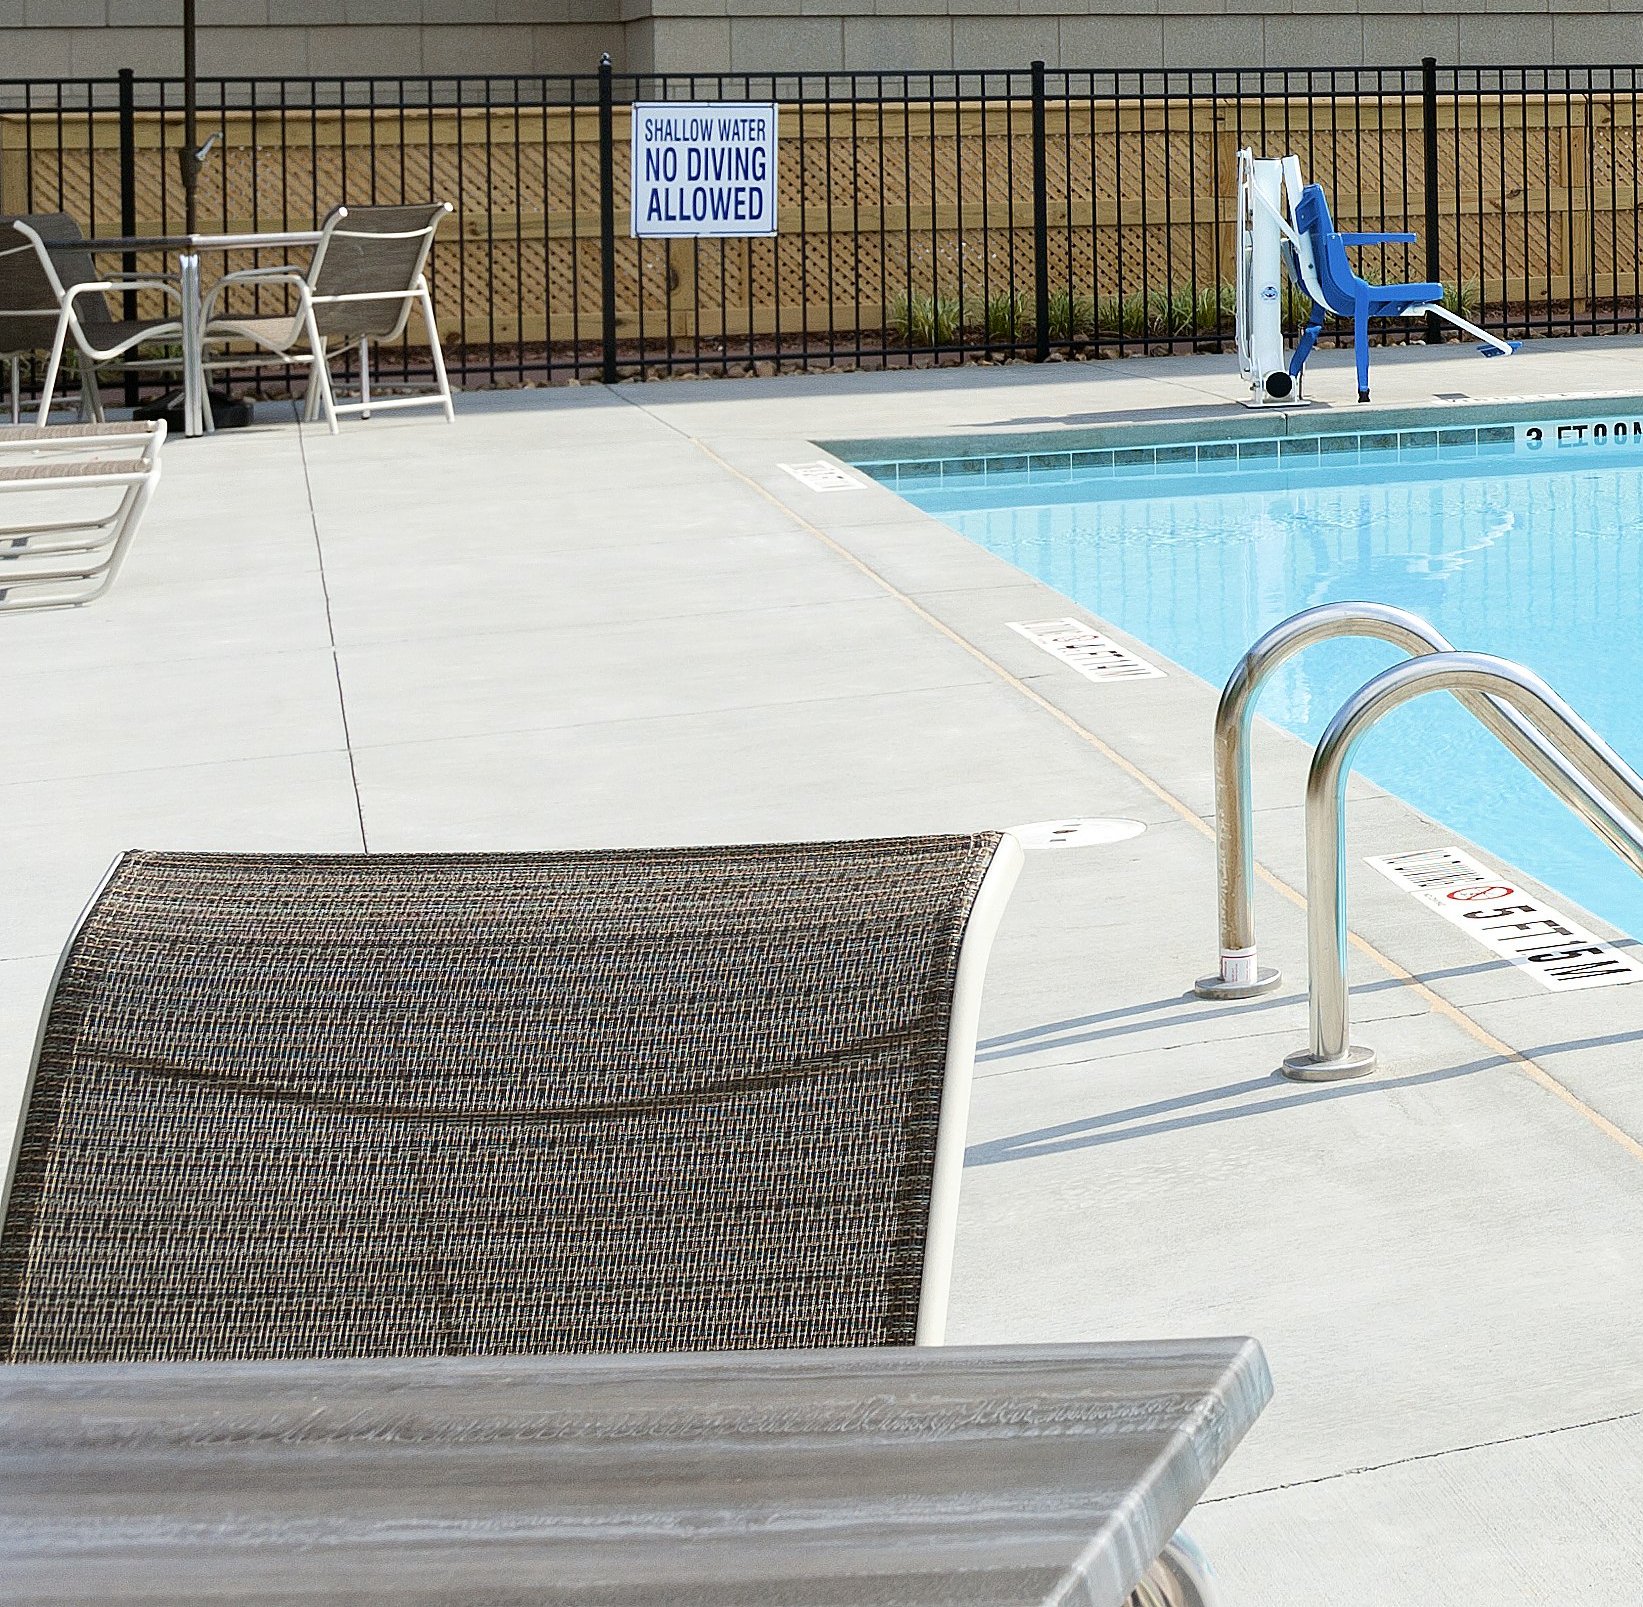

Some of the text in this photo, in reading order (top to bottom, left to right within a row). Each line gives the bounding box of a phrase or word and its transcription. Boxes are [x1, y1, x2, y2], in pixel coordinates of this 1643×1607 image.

[645, 118, 766, 142] SHALLOW WATER
[645, 146, 766, 182] NO DIVING
[647, 186, 763, 221] ALLOWED
[1462, 904, 1538, 920] 5
[1481, 919, 1575, 942] FT
